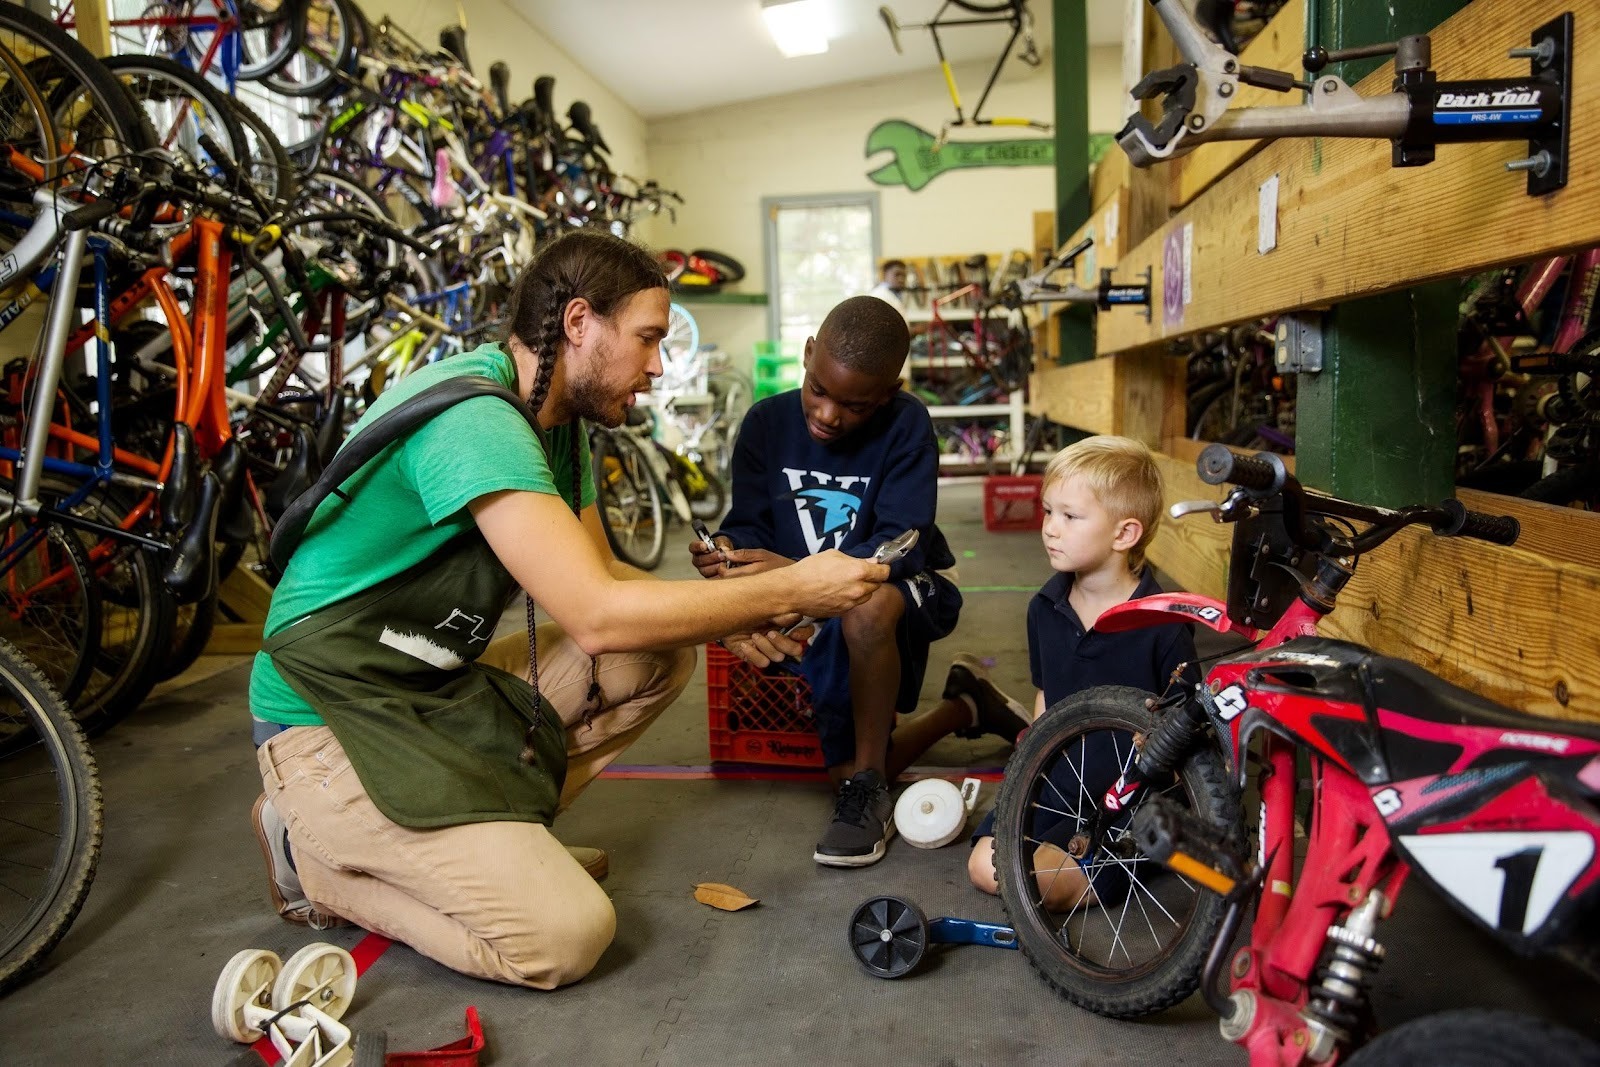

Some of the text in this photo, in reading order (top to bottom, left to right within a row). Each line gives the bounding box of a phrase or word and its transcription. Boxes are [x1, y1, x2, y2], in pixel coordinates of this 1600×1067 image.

[1436, 89, 1541, 108] Park Tool
[1471, 113, 1502, 122] PRS-4W
[1493, 844, 1545, 931] 1
